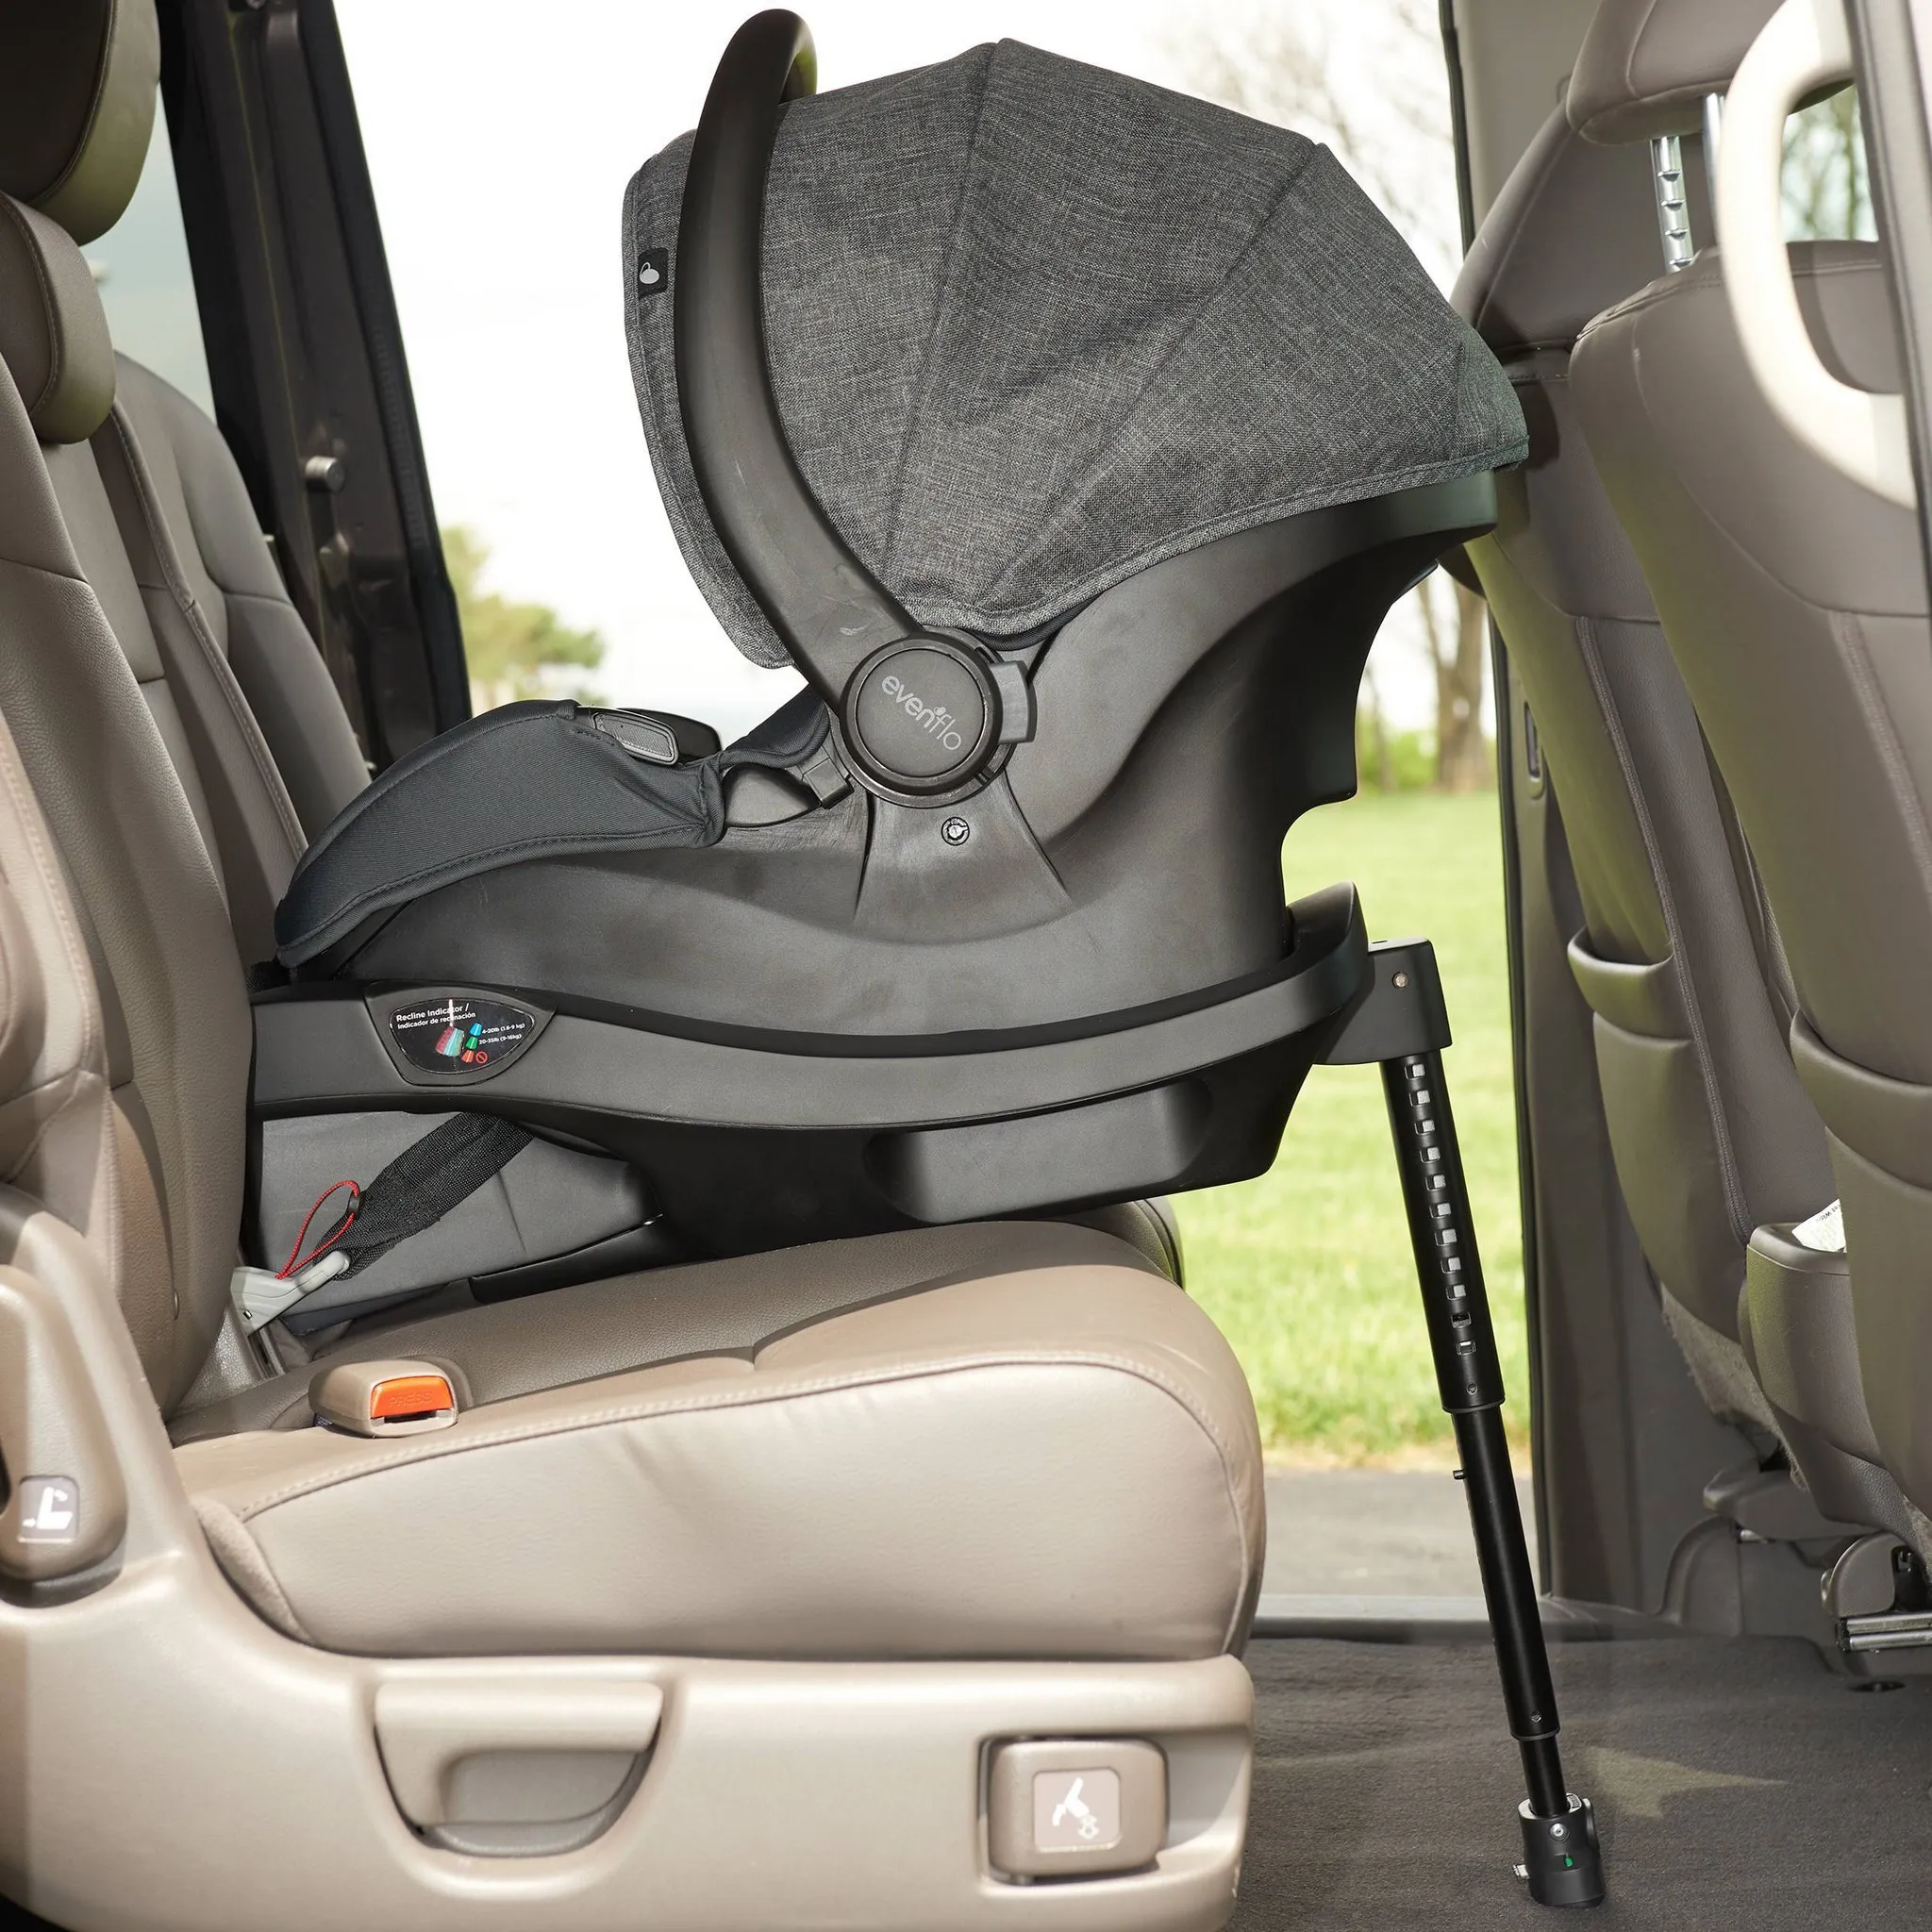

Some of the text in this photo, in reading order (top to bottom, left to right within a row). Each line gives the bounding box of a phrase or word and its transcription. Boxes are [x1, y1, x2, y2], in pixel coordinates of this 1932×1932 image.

[882, 675, 961, 750] evenflo
[396, 1003, 470, 1022] Recline Indicaor /
[397, 1020, 428, 1029] Indicador
[390, 1391, 433, 1411] PRESS
